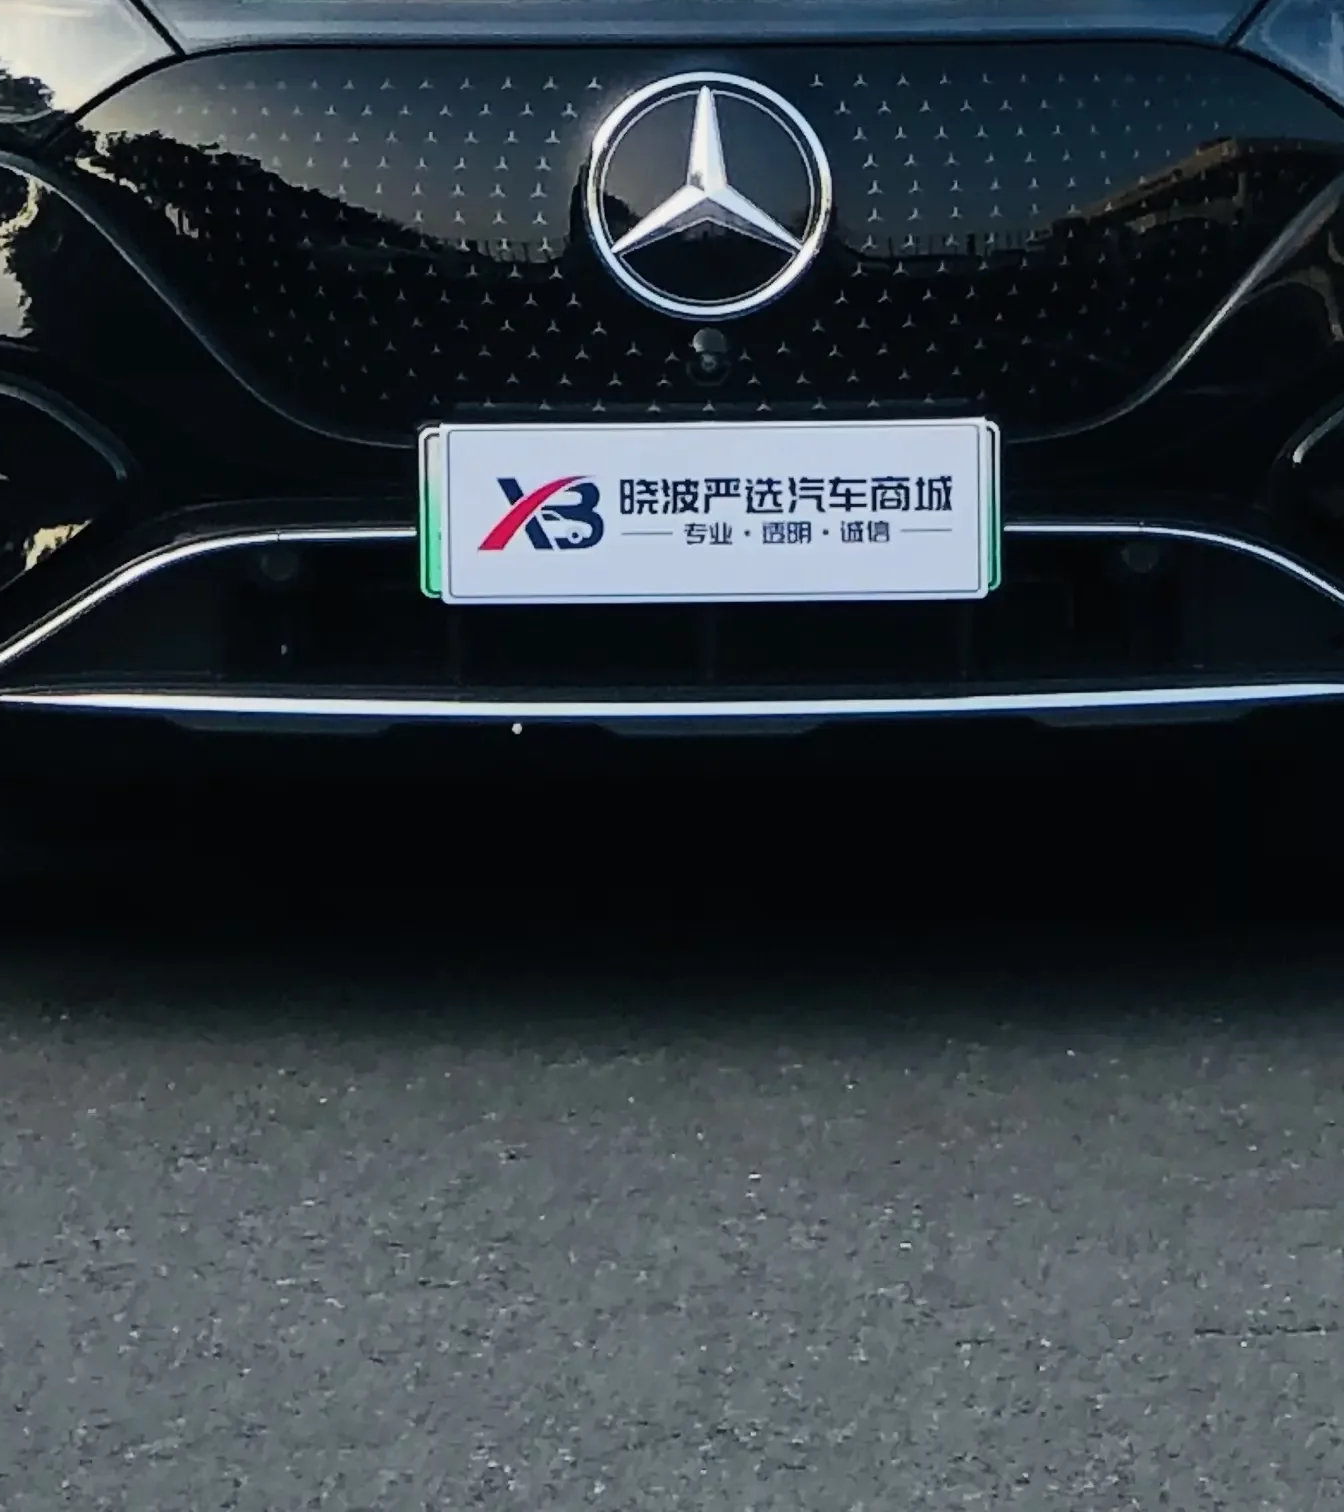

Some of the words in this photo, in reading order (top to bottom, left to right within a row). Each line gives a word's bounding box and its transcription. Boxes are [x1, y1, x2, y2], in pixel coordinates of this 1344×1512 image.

[619, 475, 952, 515] 晓波严选汽车商城
